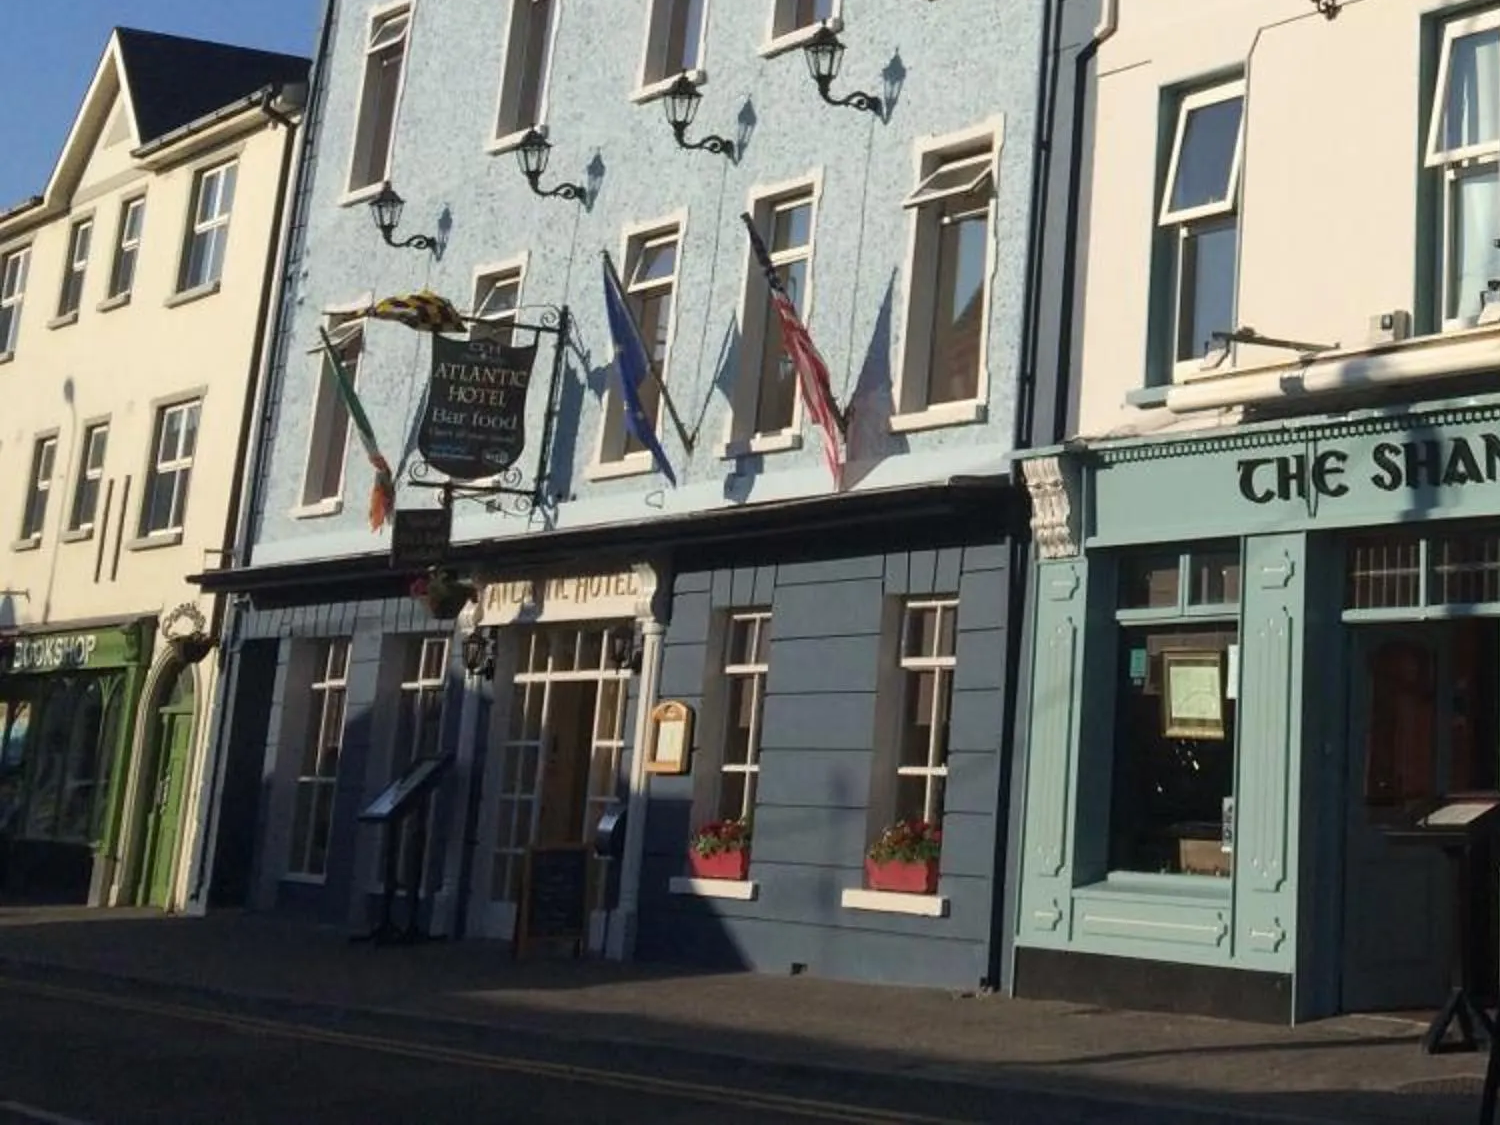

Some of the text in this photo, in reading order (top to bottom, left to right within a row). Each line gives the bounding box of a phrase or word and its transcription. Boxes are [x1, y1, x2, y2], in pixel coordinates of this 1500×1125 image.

[434, 362, 527, 388] ATLANTIC
[447, 385, 507, 408] HOTEL
[431, 406, 518, 431] Bar food
[1237, 449, 1349, 504] THE
[488, 573, 638, 611] ATLATIC HOTEL
